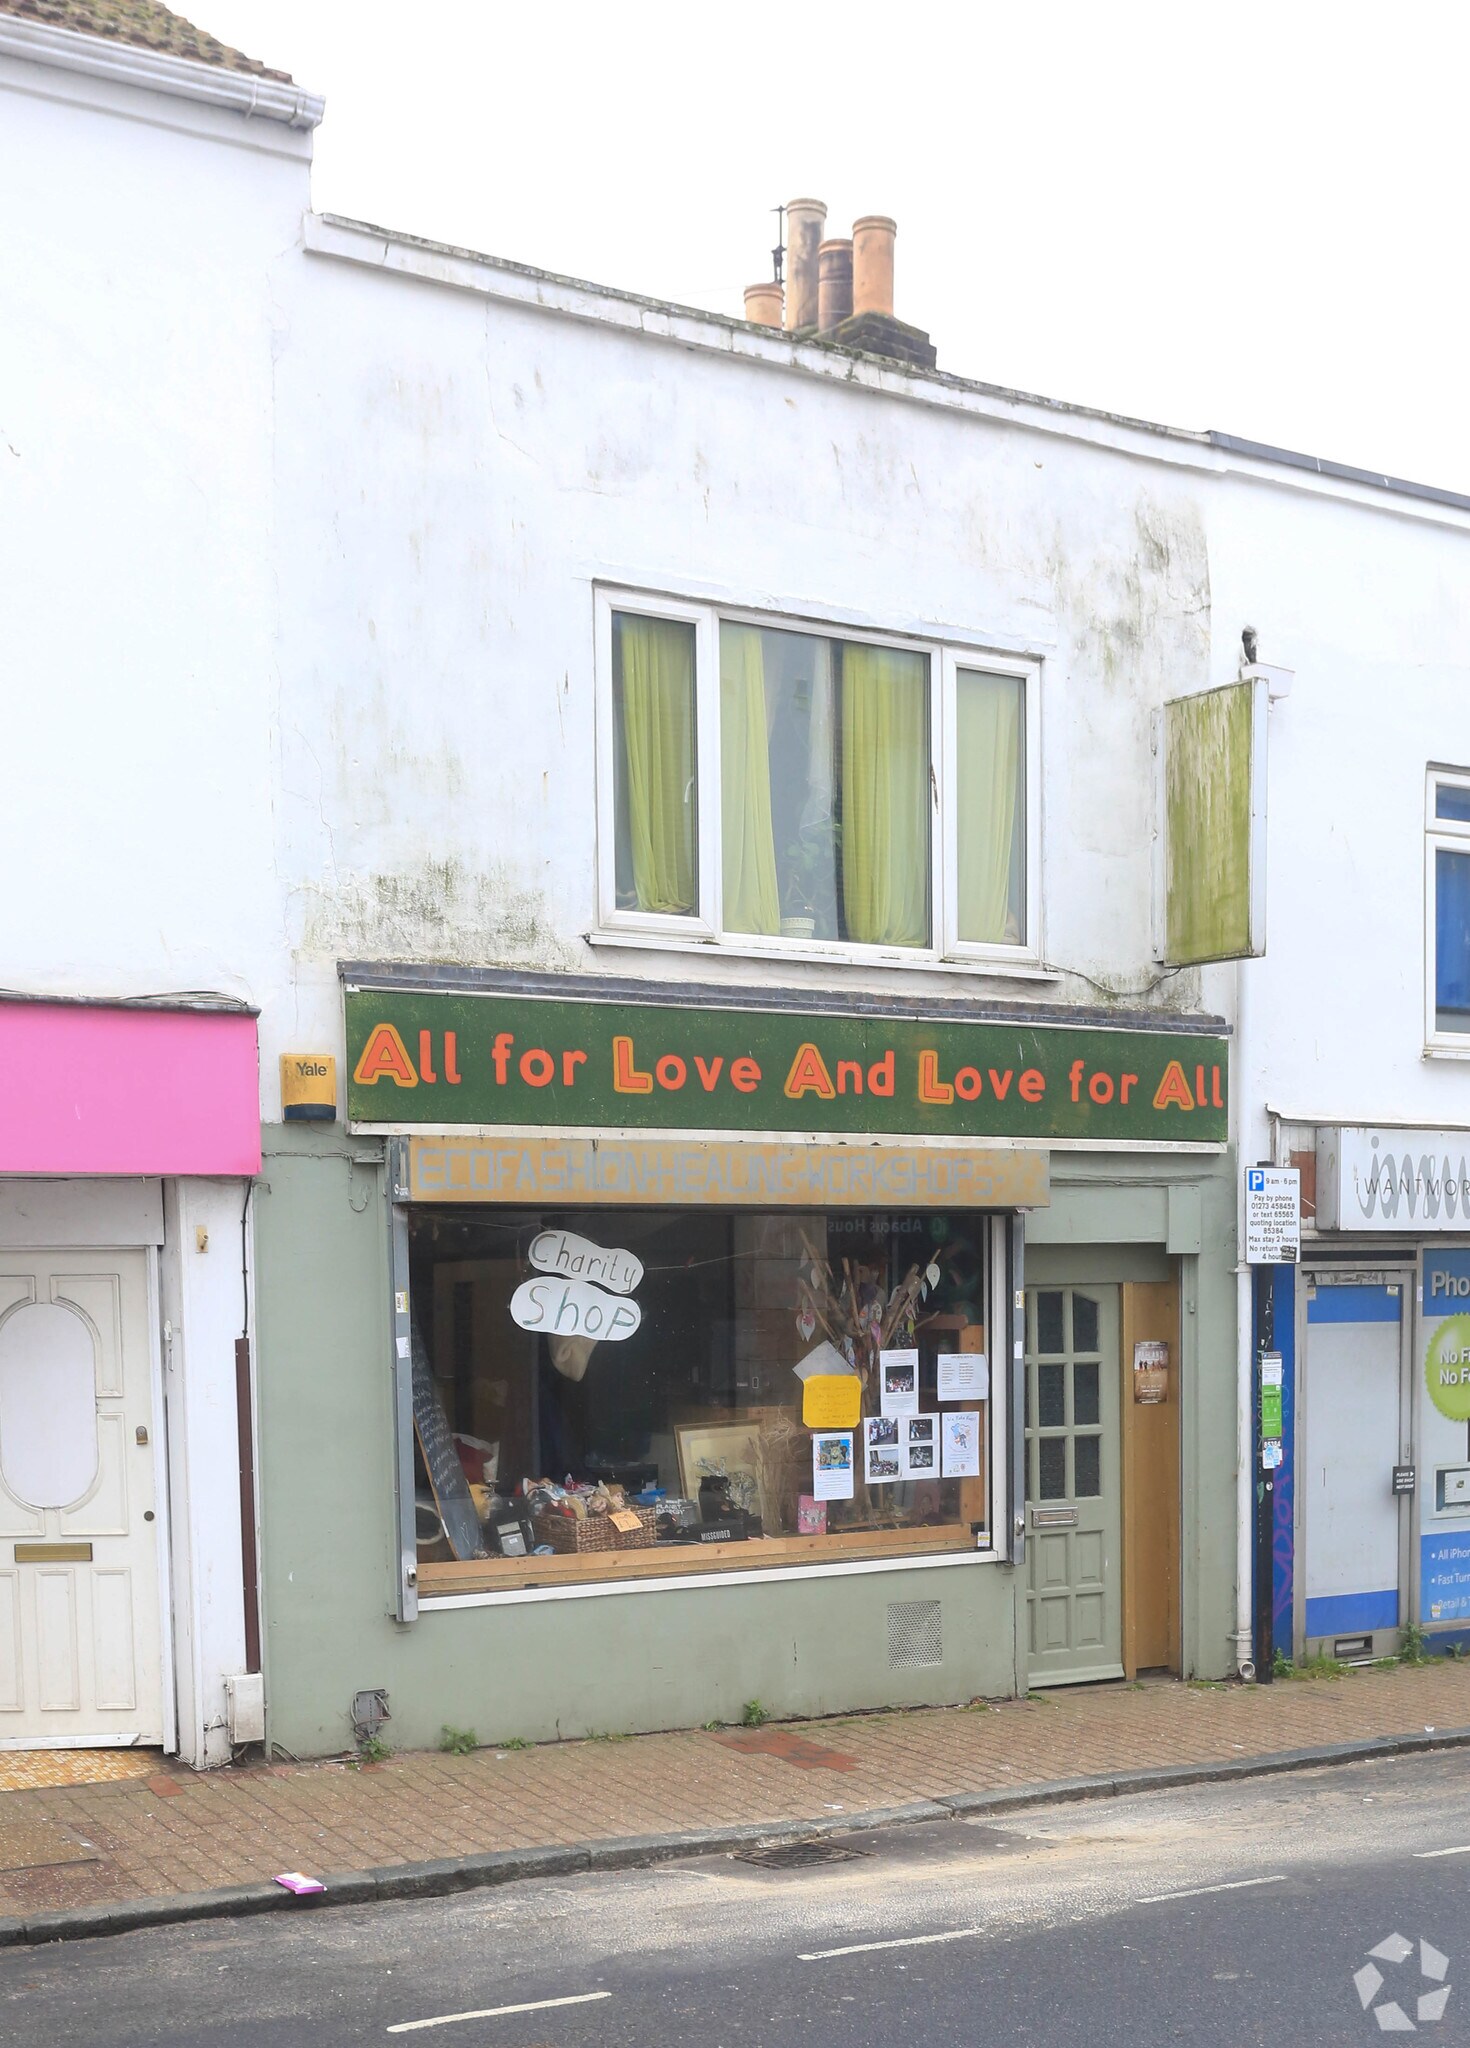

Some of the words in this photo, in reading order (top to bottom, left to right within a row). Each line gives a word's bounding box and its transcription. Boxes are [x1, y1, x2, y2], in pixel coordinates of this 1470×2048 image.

[296, 1062, 327, 1077] Yale
[353, 1023, 462, 1088] All
[491, 1033, 588, 1088] for
[612, 1036, 762, 1094] Love
[784, 1043, 895, 1100] And
[918, 1050, 1046, 1105] Love
[1069, 1060, 1138, 1105] for
[1153, 1060, 1224, 1111] All
[1262, 1236, 1275, 1244] stay
[532, 1234, 636, 1293] Charity
[1440, 1351, 1458, 1364] No
[1440, 1369, 1458, 1385] No
[1438, 1549, 1449, 1560] All
[1438, 1574, 1453, 1585] Fast
